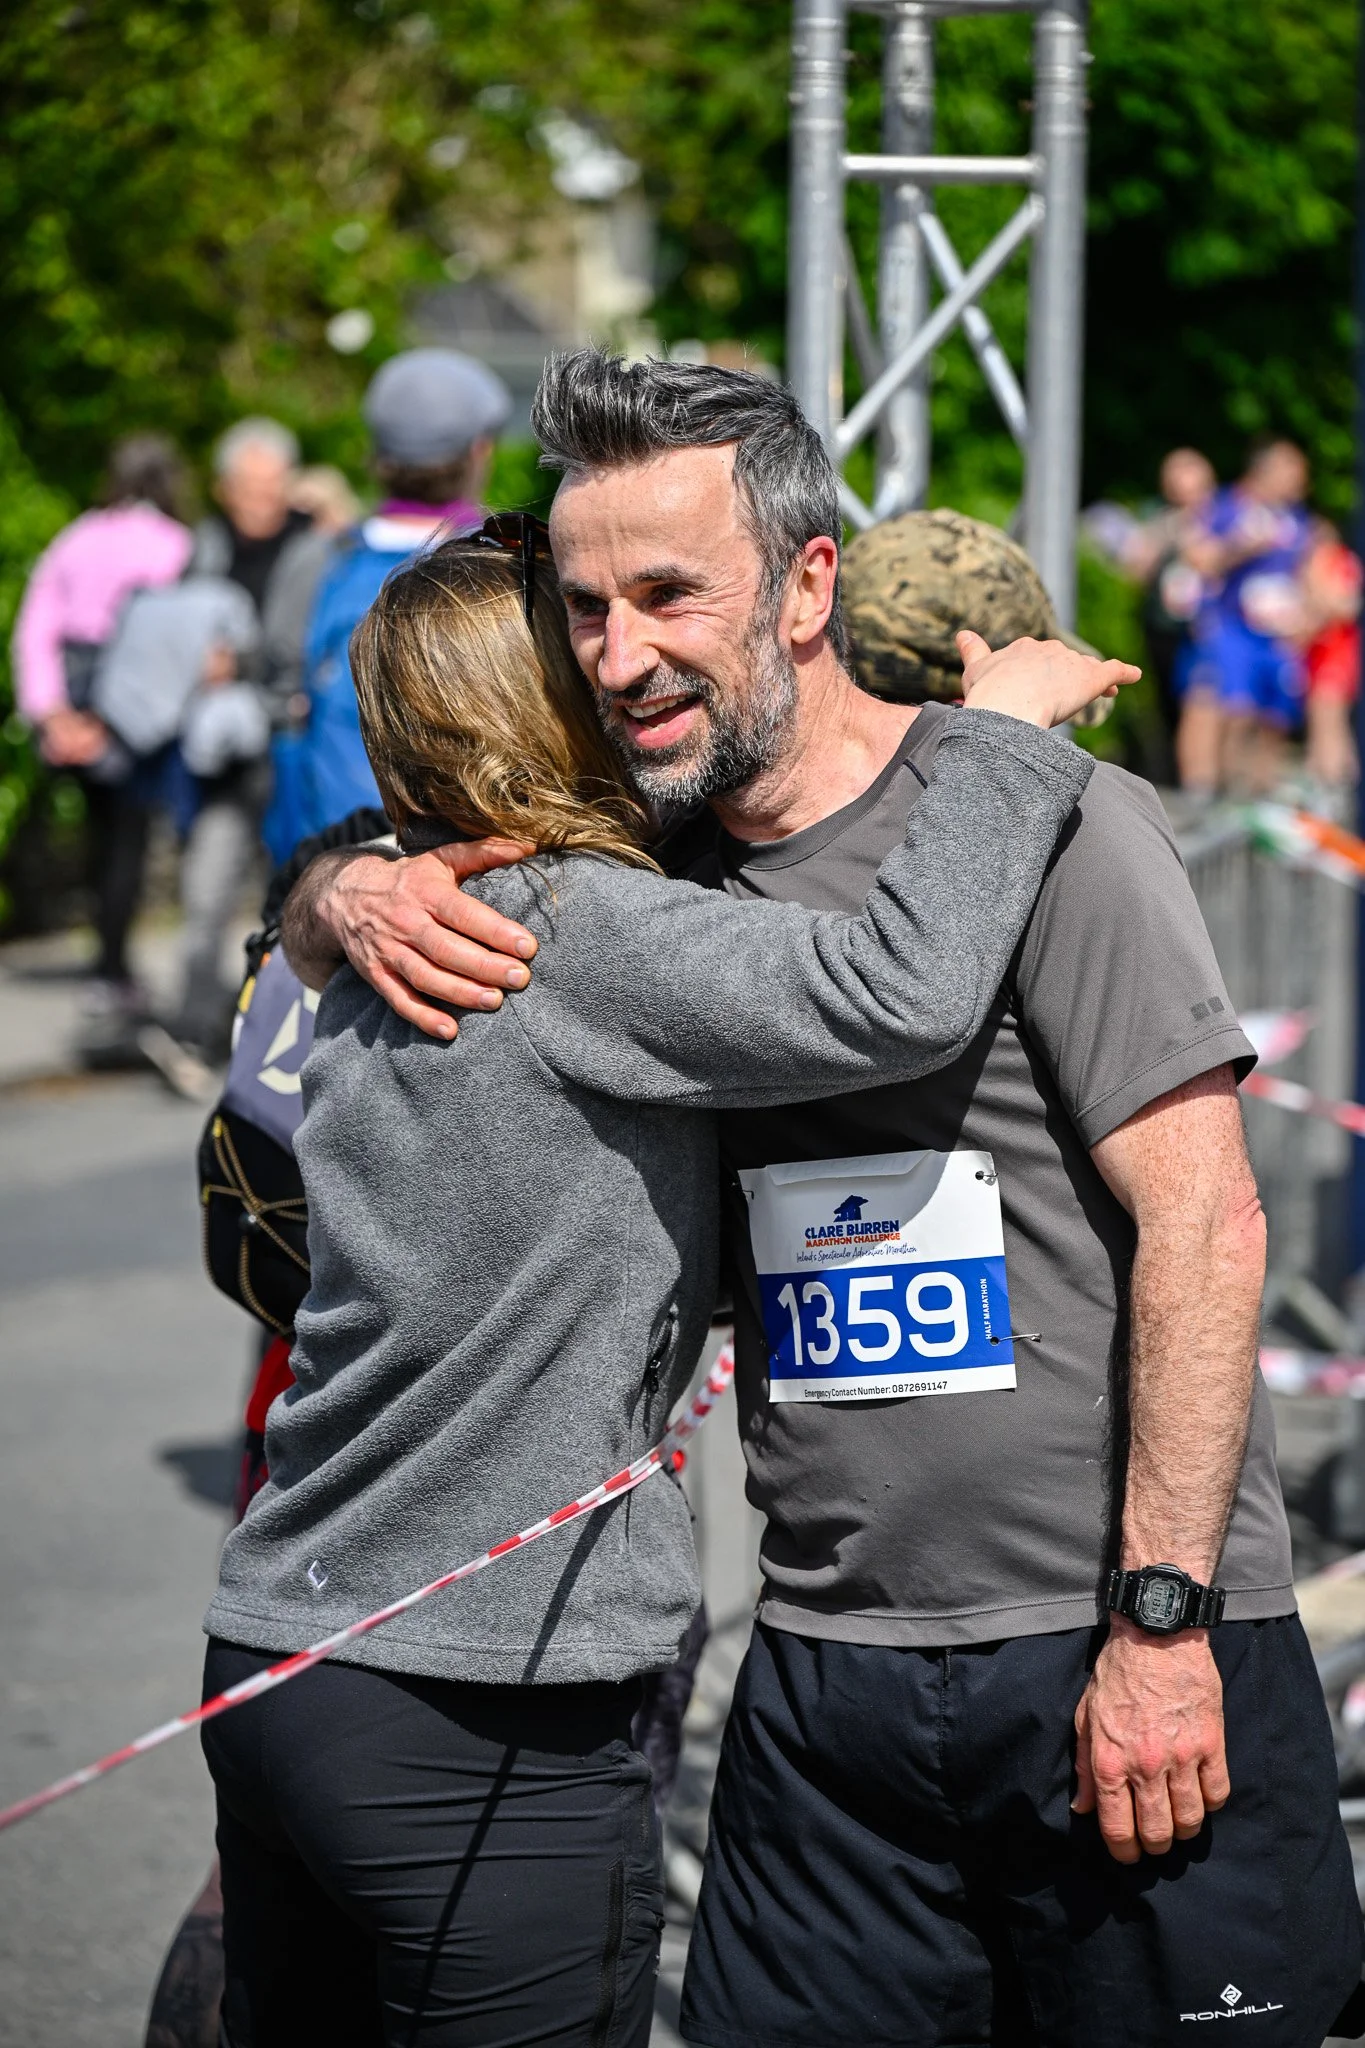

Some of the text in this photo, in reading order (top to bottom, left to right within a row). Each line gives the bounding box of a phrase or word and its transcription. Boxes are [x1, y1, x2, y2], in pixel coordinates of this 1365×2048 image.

[804, 1220, 900, 1240] CLARE BURREN
[805, 1232, 901, 1248] MARATHON CHALLENGE
[817, 1247, 852, 1264] Spectacular
[852, 1246, 884, 1258] Adventure
[884, 1242, 917, 1256] Marathon
[777, 1271, 970, 1366] 1359
[980, 1278, 993, 1340] HALF MARATHON
[804, 1381, 948, 1399] Emergency Contact Number: 0872691147
[1180, 2001, 1284, 2021] RONHILL
